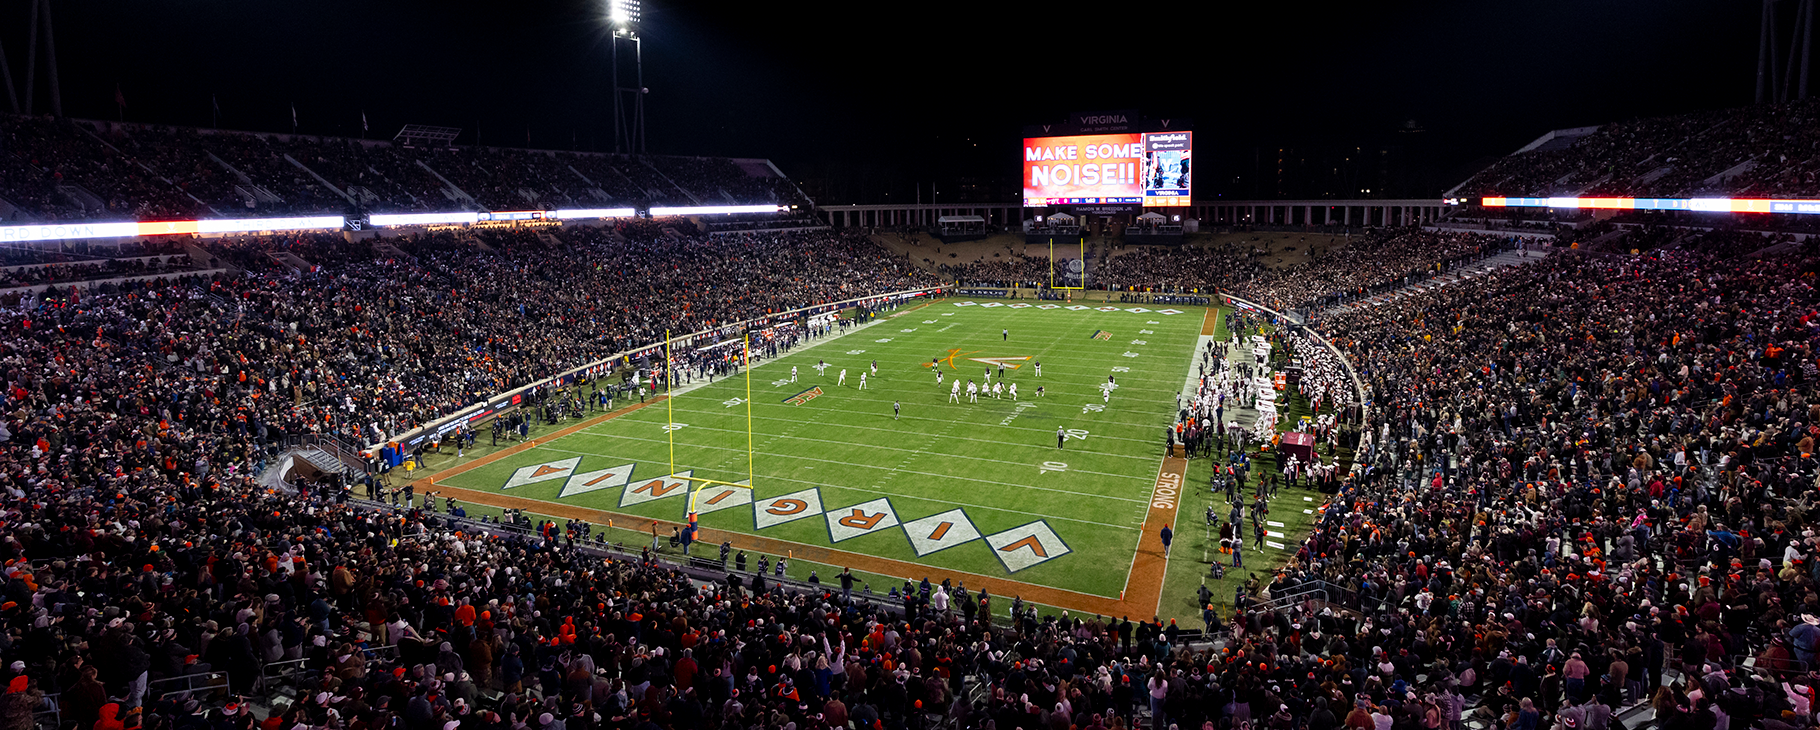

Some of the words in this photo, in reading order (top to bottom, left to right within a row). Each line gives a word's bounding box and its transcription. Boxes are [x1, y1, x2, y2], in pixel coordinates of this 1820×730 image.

[1081, 115, 1128, 125] VIRGINIA
[1026, 146, 1077, 161] MAKE
[1085, 143, 1141, 159] SOME
[1032, 162, 1135, 186] NOISE!!
[279, 219, 315, 229] DOWN
[41, 226, 94, 238] DOWN
[1063, 428, 1089, 440] 20
[1040, 461, 1068, 473] 10
[1152, 472, 1181, 509] STRONG
[1713, 543, 1719, 552] 6
